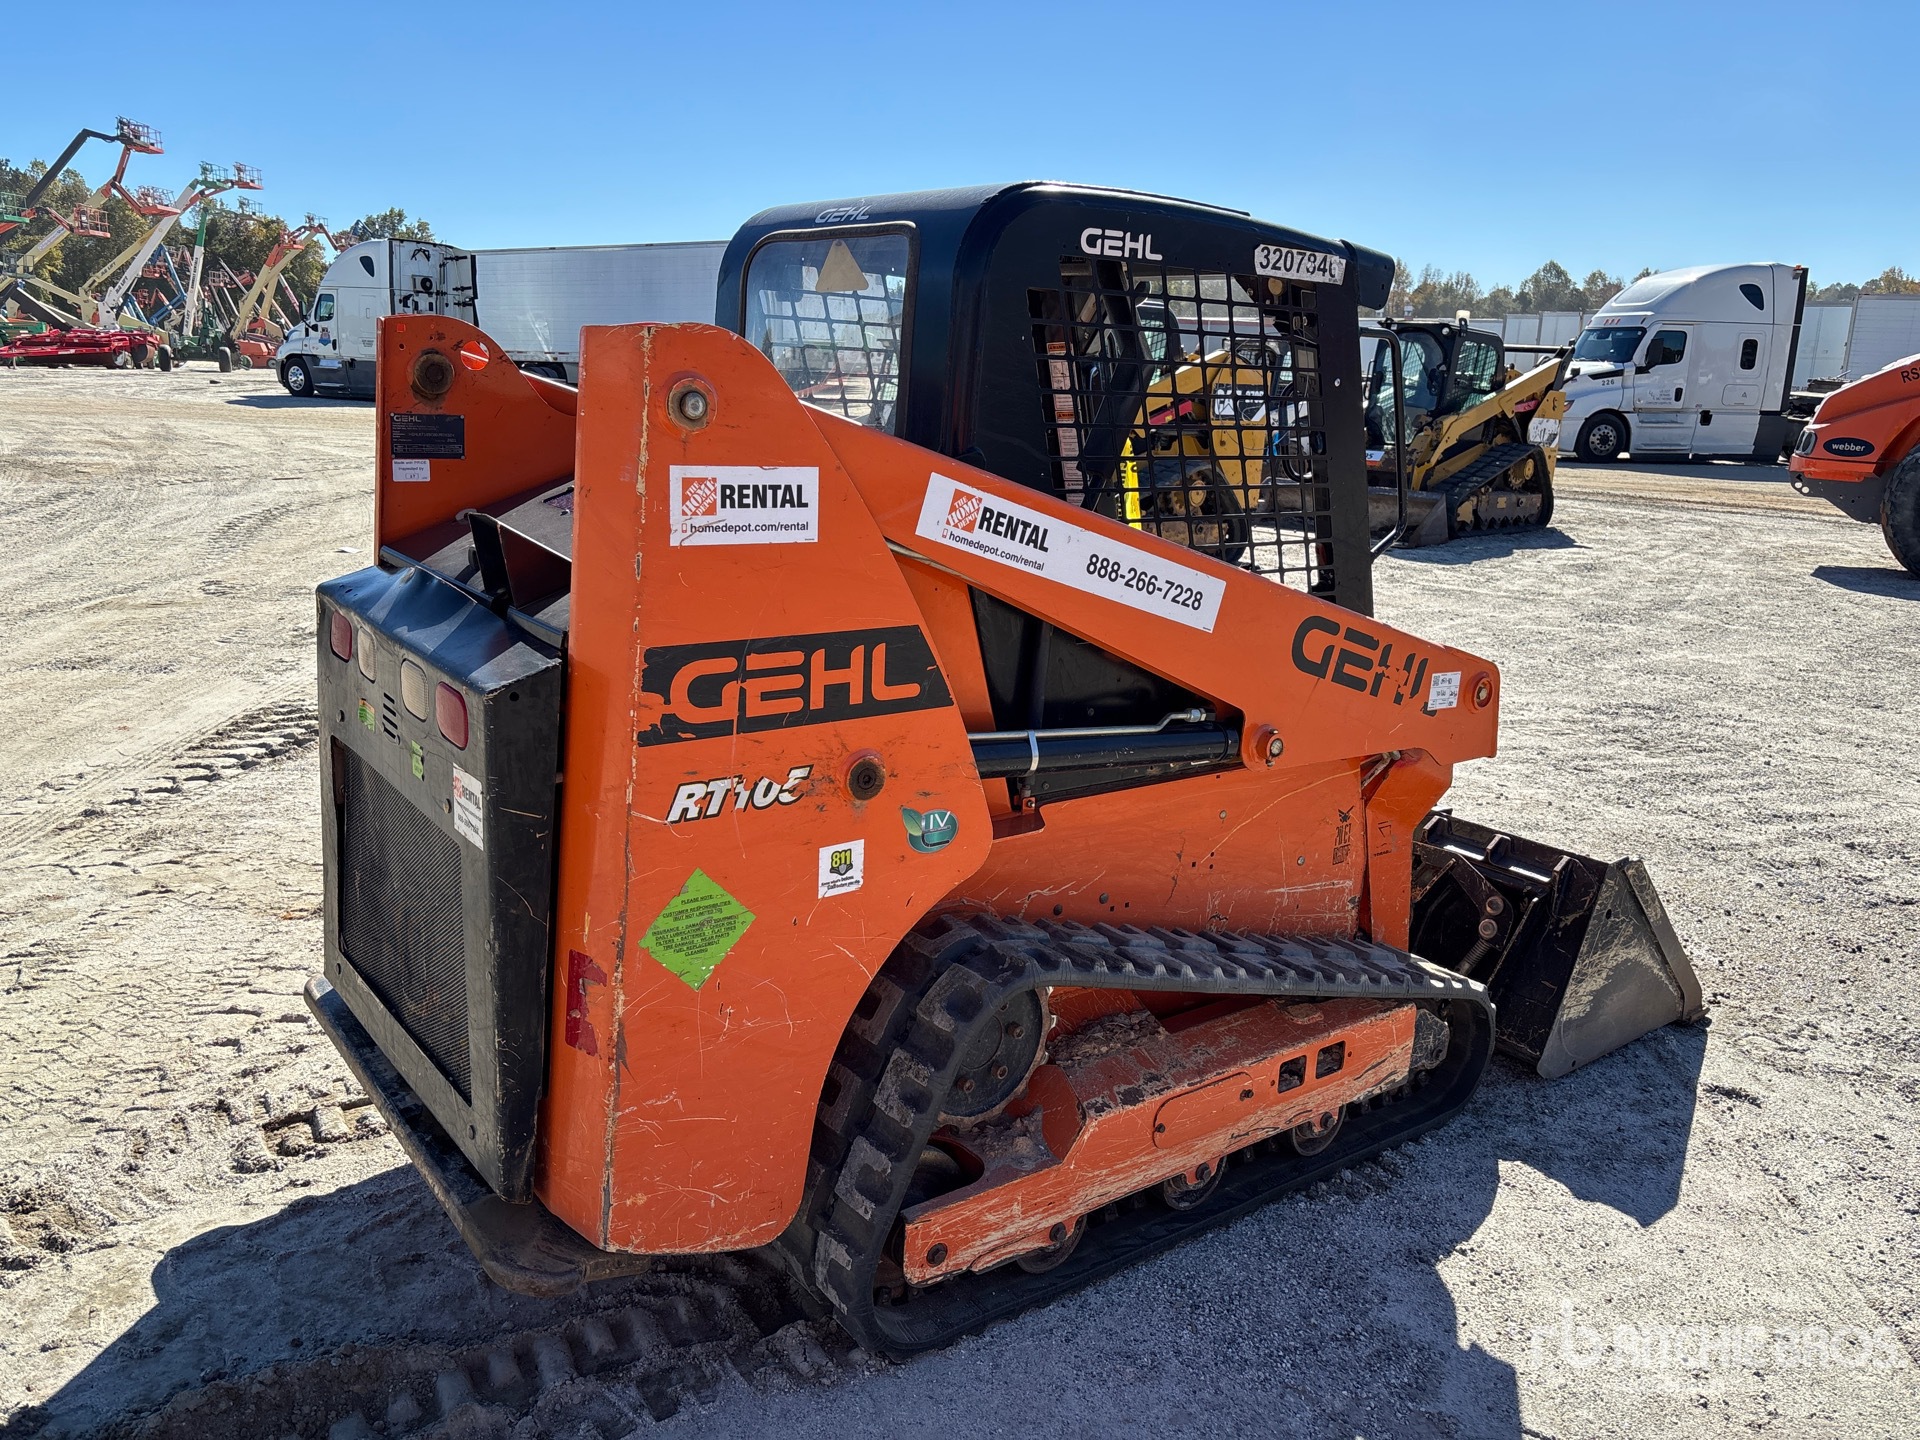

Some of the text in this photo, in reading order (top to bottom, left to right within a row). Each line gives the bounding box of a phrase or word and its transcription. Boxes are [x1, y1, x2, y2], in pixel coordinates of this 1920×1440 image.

[815, 205, 872, 224] GEHL
[1080, 228, 1162, 260] GEHL
[1901, 366, 1920, 383] RS
[1832, 442, 1865, 452] webber
[682, 477, 717, 516] HOME
[685, 480, 701, 496] THE
[720, 484, 808, 509] RENTAL
[696, 491, 717, 516] DEPOT
[946, 496, 980, 526] HOME
[954, 495, 968, 509] THE
[690, 521, 809, 534] homedepot.com/rental
[958, 510, 979, 529] DEPOT
[978, 506, 1049, 553] RENTAL
[949, 531, 1044, 571] homedepot.com/rental
[1086, 554, 1203, 611] 888-266-7228
[670, 642, 921, 724] GEHL
[666, 764, 814, 824] RT105
[929, 811, 951, 829] IV
[832, 849, 851, 868] 811
[663, 901, 731, 918] CUSTOMER RESPONSIBILITIES
[681, 897, 699, 905] PLEASE
[652, 926, 679, 936] INSURANCE
[656, 939, 674, 947] FILTERS
[681, 932, 705, 940] BATTERIES
[674, 940, 694, 948] DAMAGE
[685, 948, 708, 956] CLEANING
[686, 940, 720, 950] REPLACEMENT
